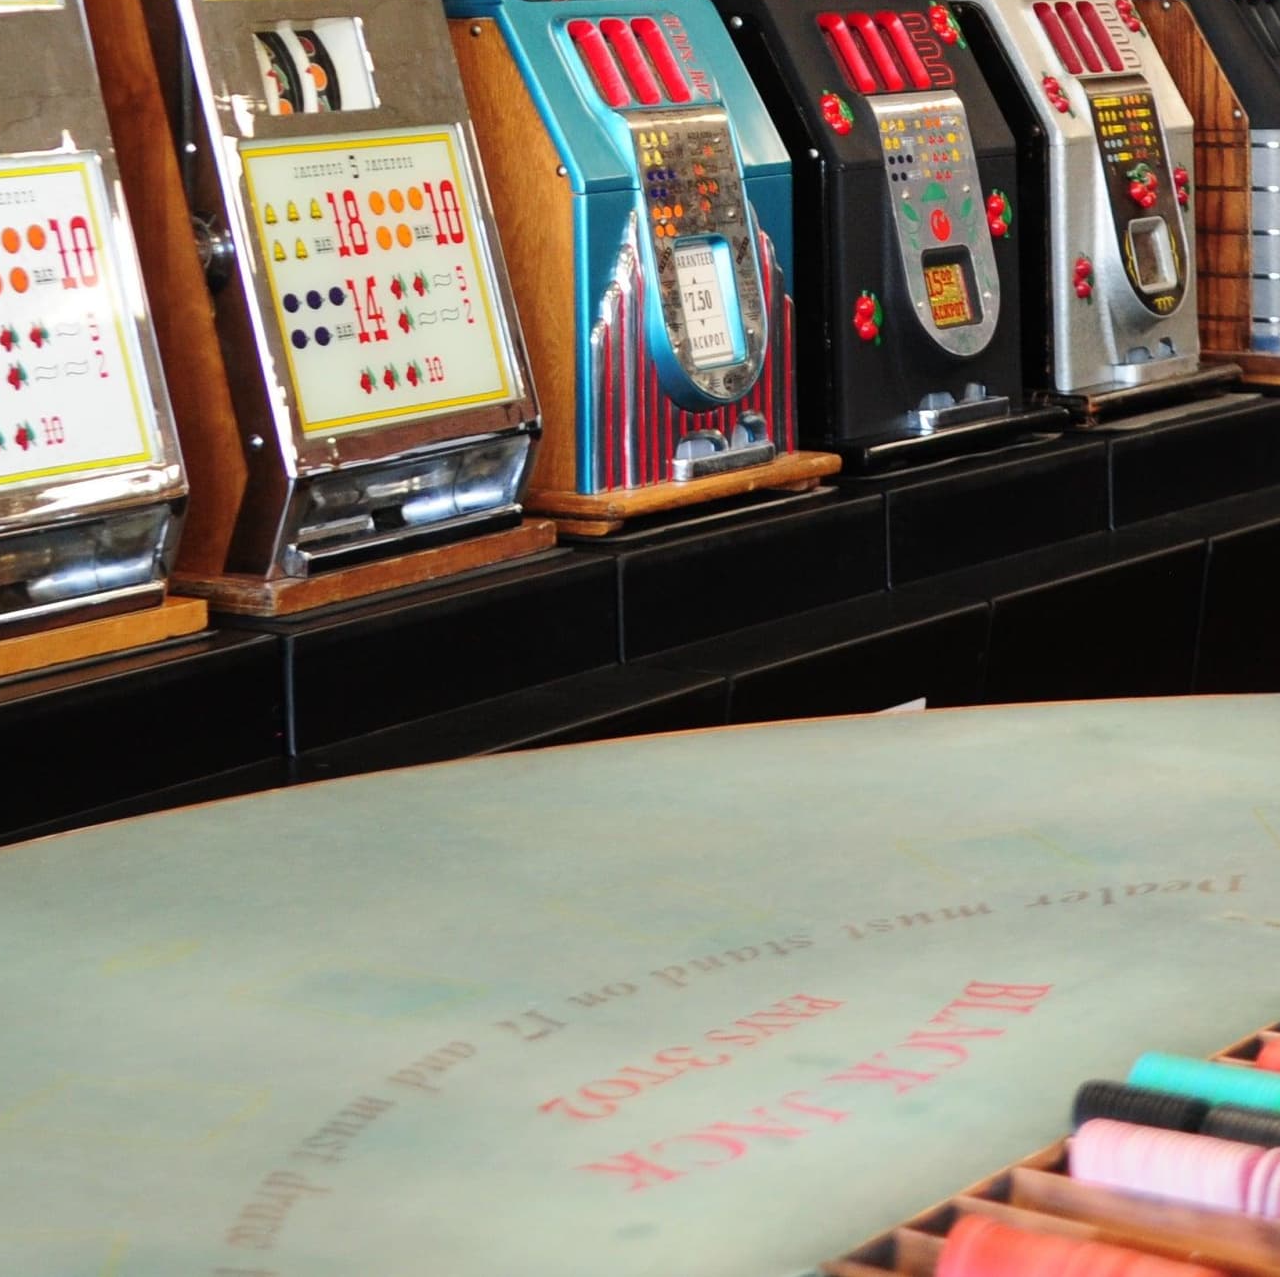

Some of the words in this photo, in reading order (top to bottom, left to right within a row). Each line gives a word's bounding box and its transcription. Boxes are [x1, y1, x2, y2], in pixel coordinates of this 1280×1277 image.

[325, 189, 369, 258] 18
[422, 178, 466, 246] 10
[48, 215, 99, 290] 10
[345, 276, 389, 344] 14
[683, 289, 714, 313] $7.50
[692, 331, 726, 351] ACKPOT
[425, 356, 445, 383] 10
[41, 415, 65, 445] 10
[1025, 873, 1248, 908] Dealer
[841, 901, 994, 941] must
[650, 933, 815, 990] stand
[566, 981, 639, 1008] on
[703, 992, 848, 1047] PAYS
[824, 979, 1055, 1097] BLACK
[386, 1040, 477, 1095] and
[573, 1089, 854, 1192] JACK
